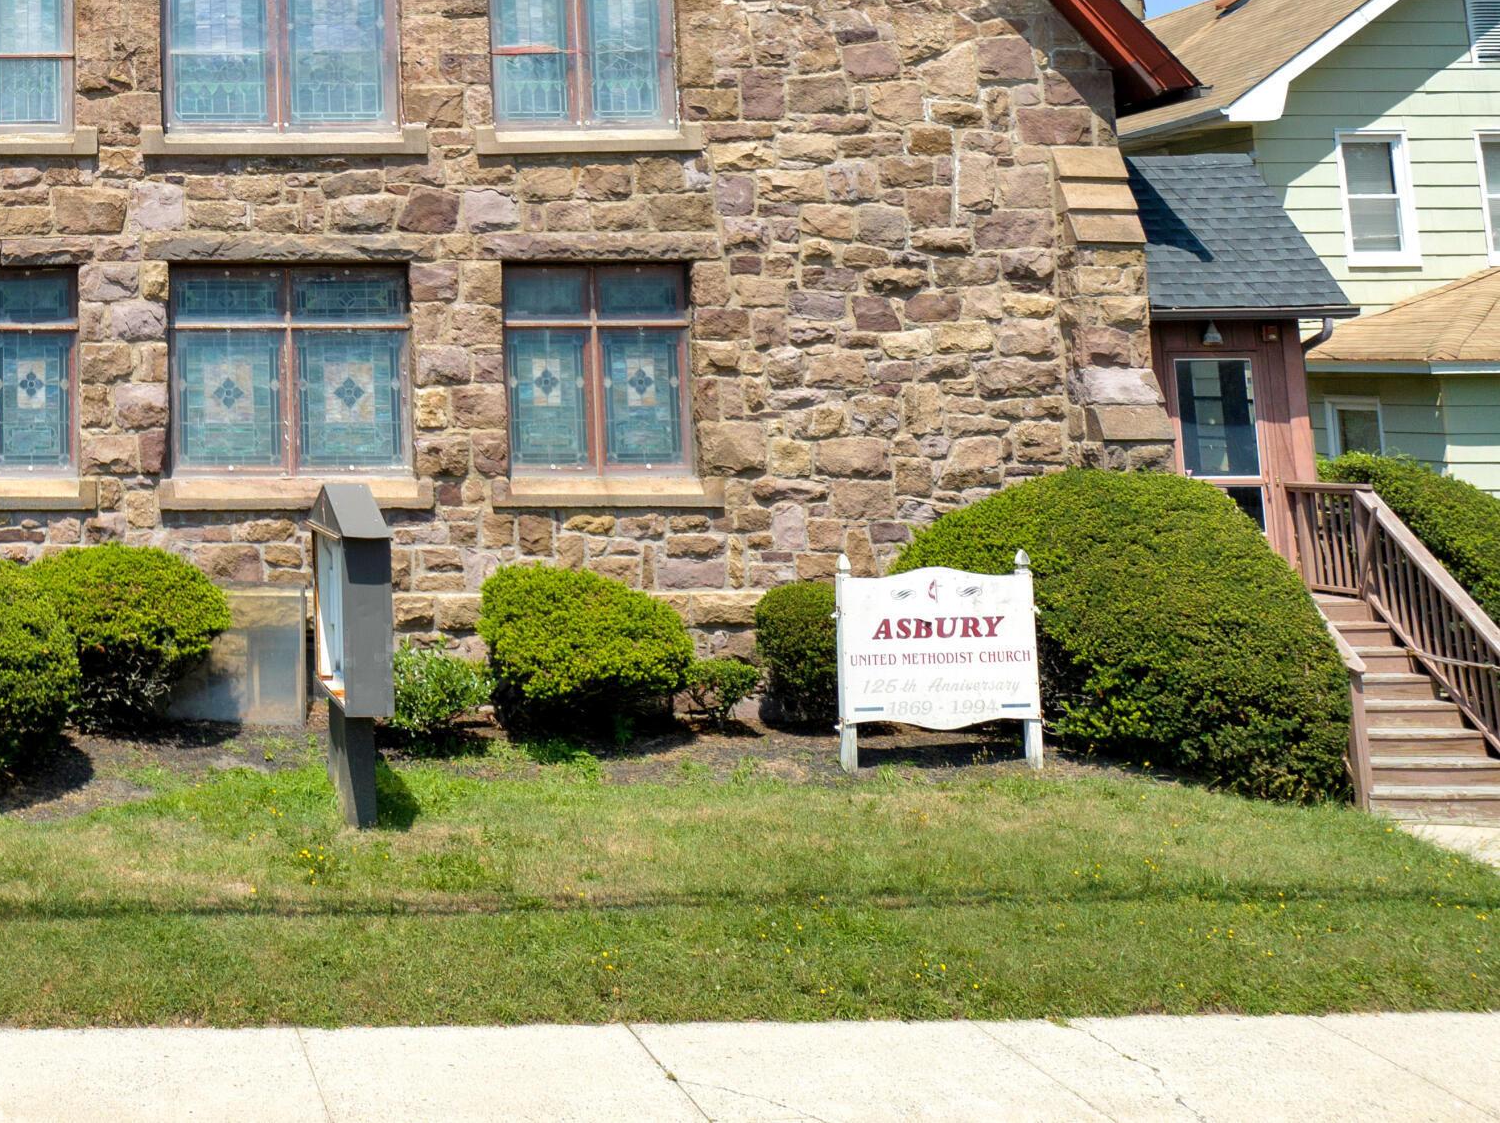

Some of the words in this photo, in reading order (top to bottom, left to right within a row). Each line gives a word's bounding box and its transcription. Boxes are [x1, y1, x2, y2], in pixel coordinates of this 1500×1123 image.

[871, 615, 1006, 640] ASBURY
[850, 653, 897, 667] UNITED
[902, 651, 974, 665] METHODIST
[979, 649, 1032, 663] CHURCH
[928, 677, 1021, 696] Anniversary
[887, 700, 933, 716] 1869
[950, 698, 998, 715] 1994
